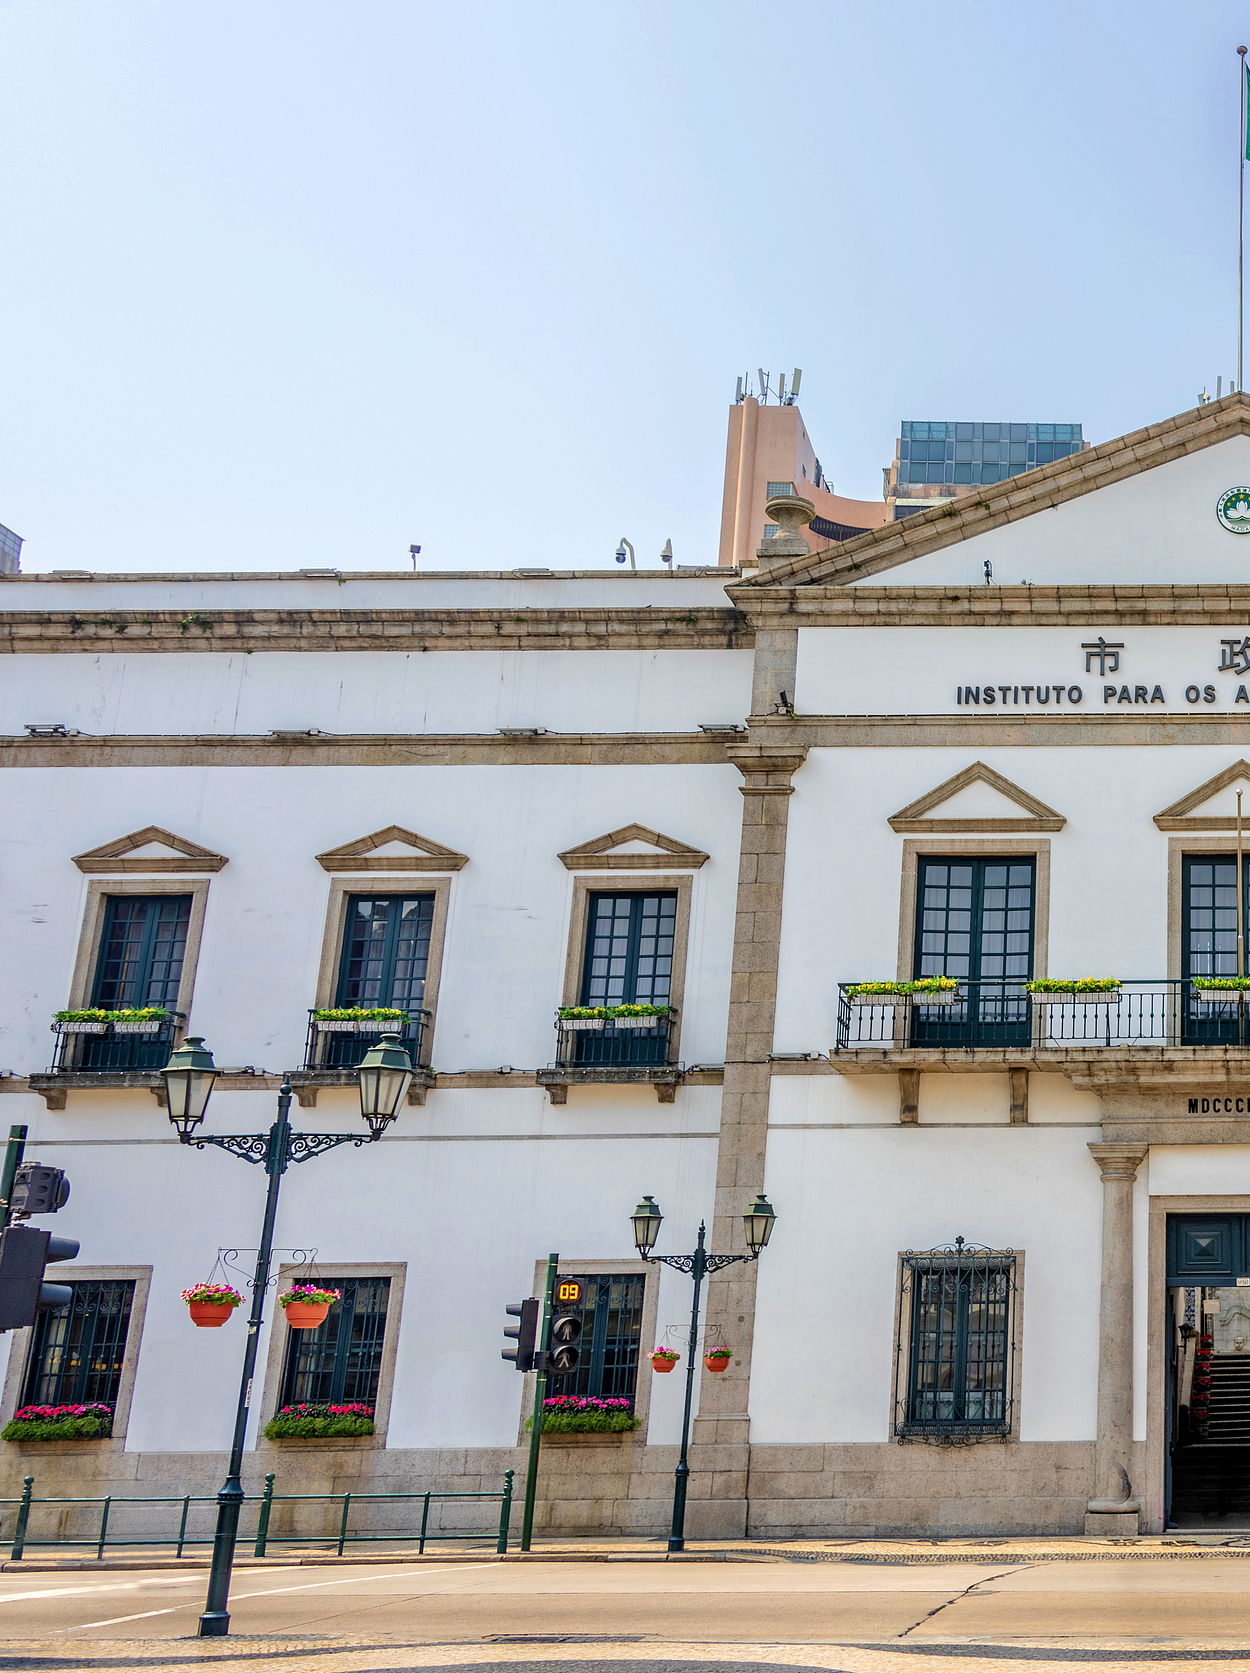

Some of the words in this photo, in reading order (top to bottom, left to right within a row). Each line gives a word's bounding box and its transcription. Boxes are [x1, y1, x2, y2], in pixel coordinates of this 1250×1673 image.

[956, 685, 1083, 705] INSTITUTO
[1103, 685, 1165, 704] PARA
[1185, 684, 1216, 703] OS
[559, 1284, 579, 1300] 09
